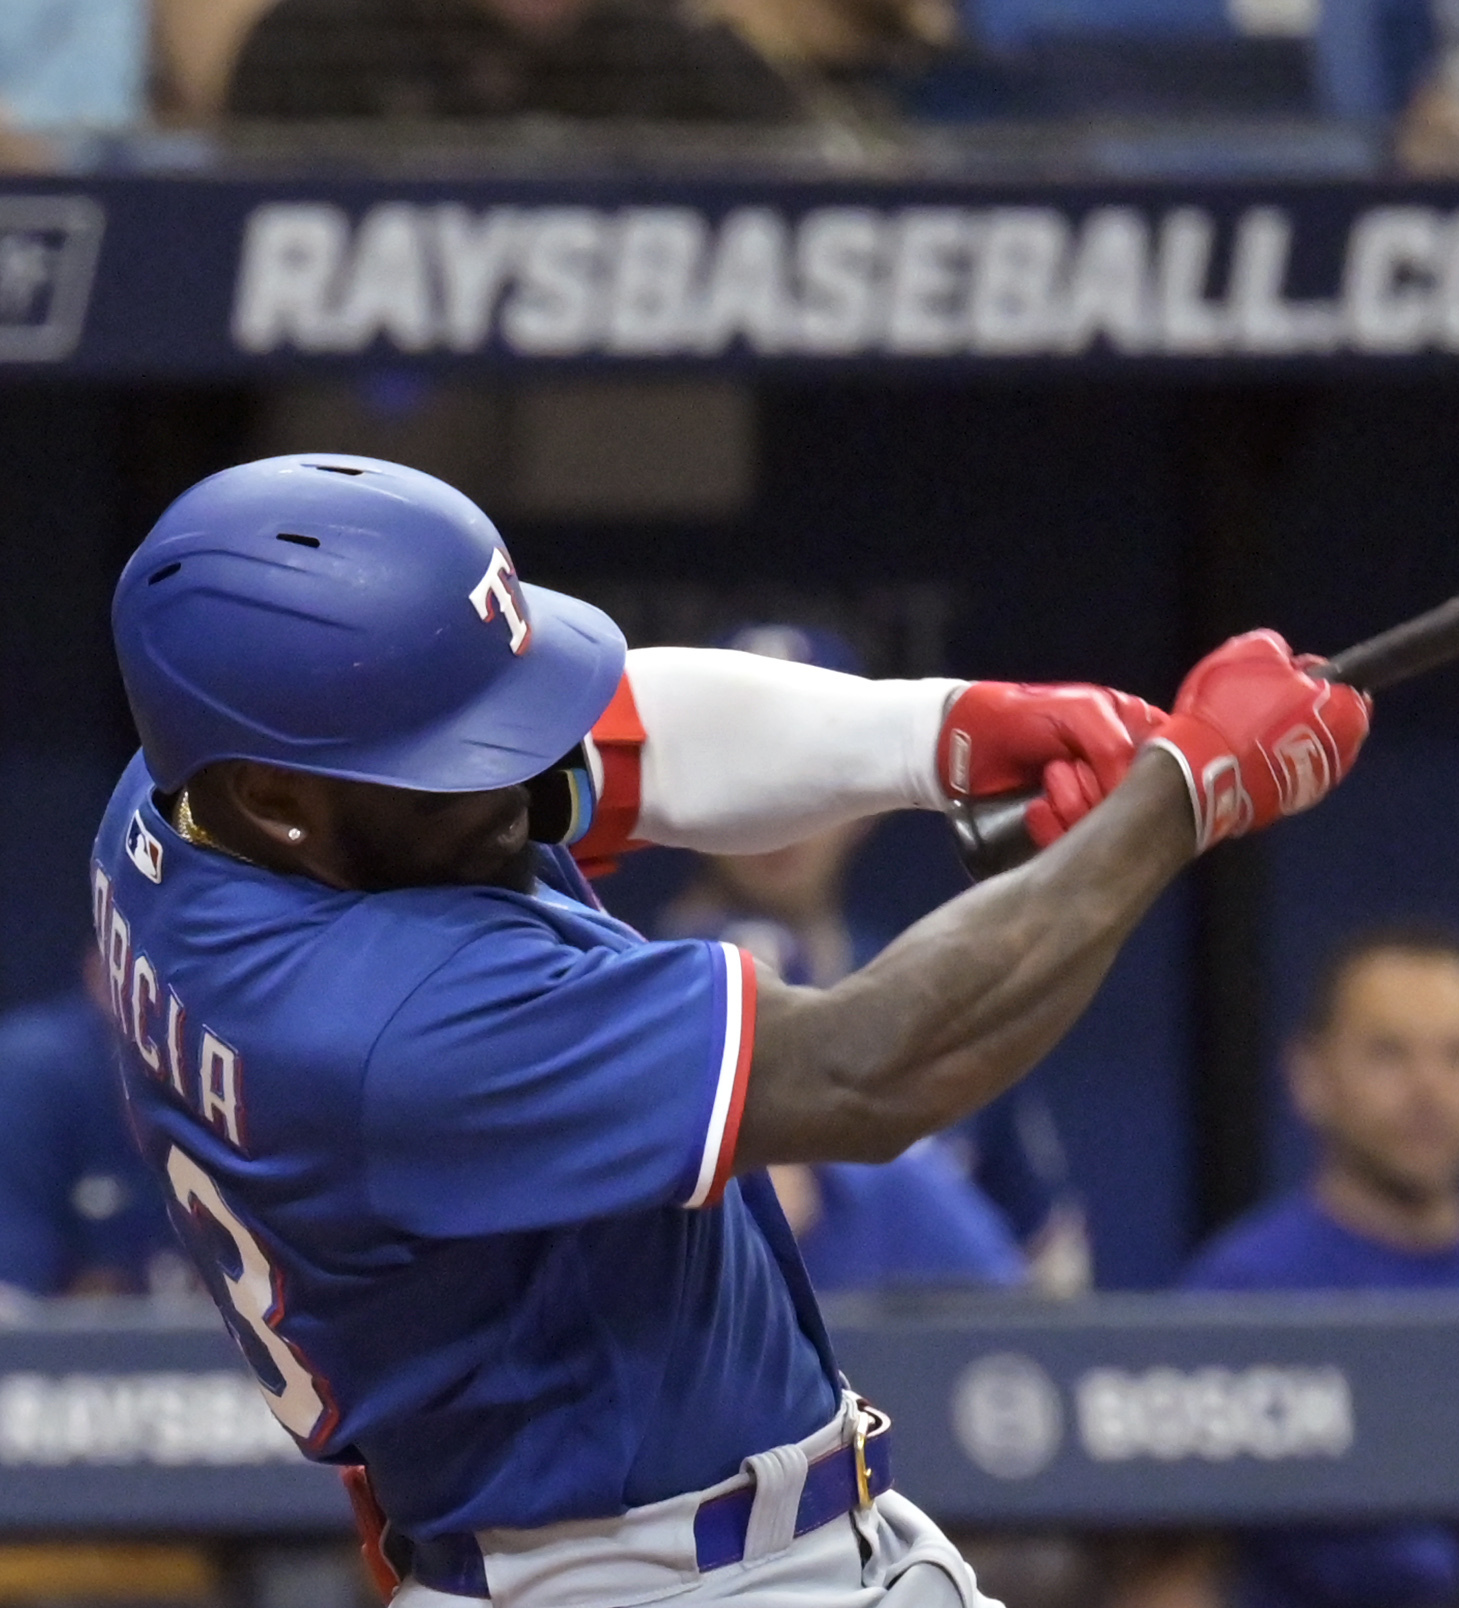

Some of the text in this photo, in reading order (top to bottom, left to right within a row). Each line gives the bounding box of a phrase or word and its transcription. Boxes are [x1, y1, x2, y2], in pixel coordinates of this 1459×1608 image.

[468, 546, 533, 656] T
[91, 857, 253, 1160] ARCIA
[1079, 1363, 1357, 1463] BOSCH
